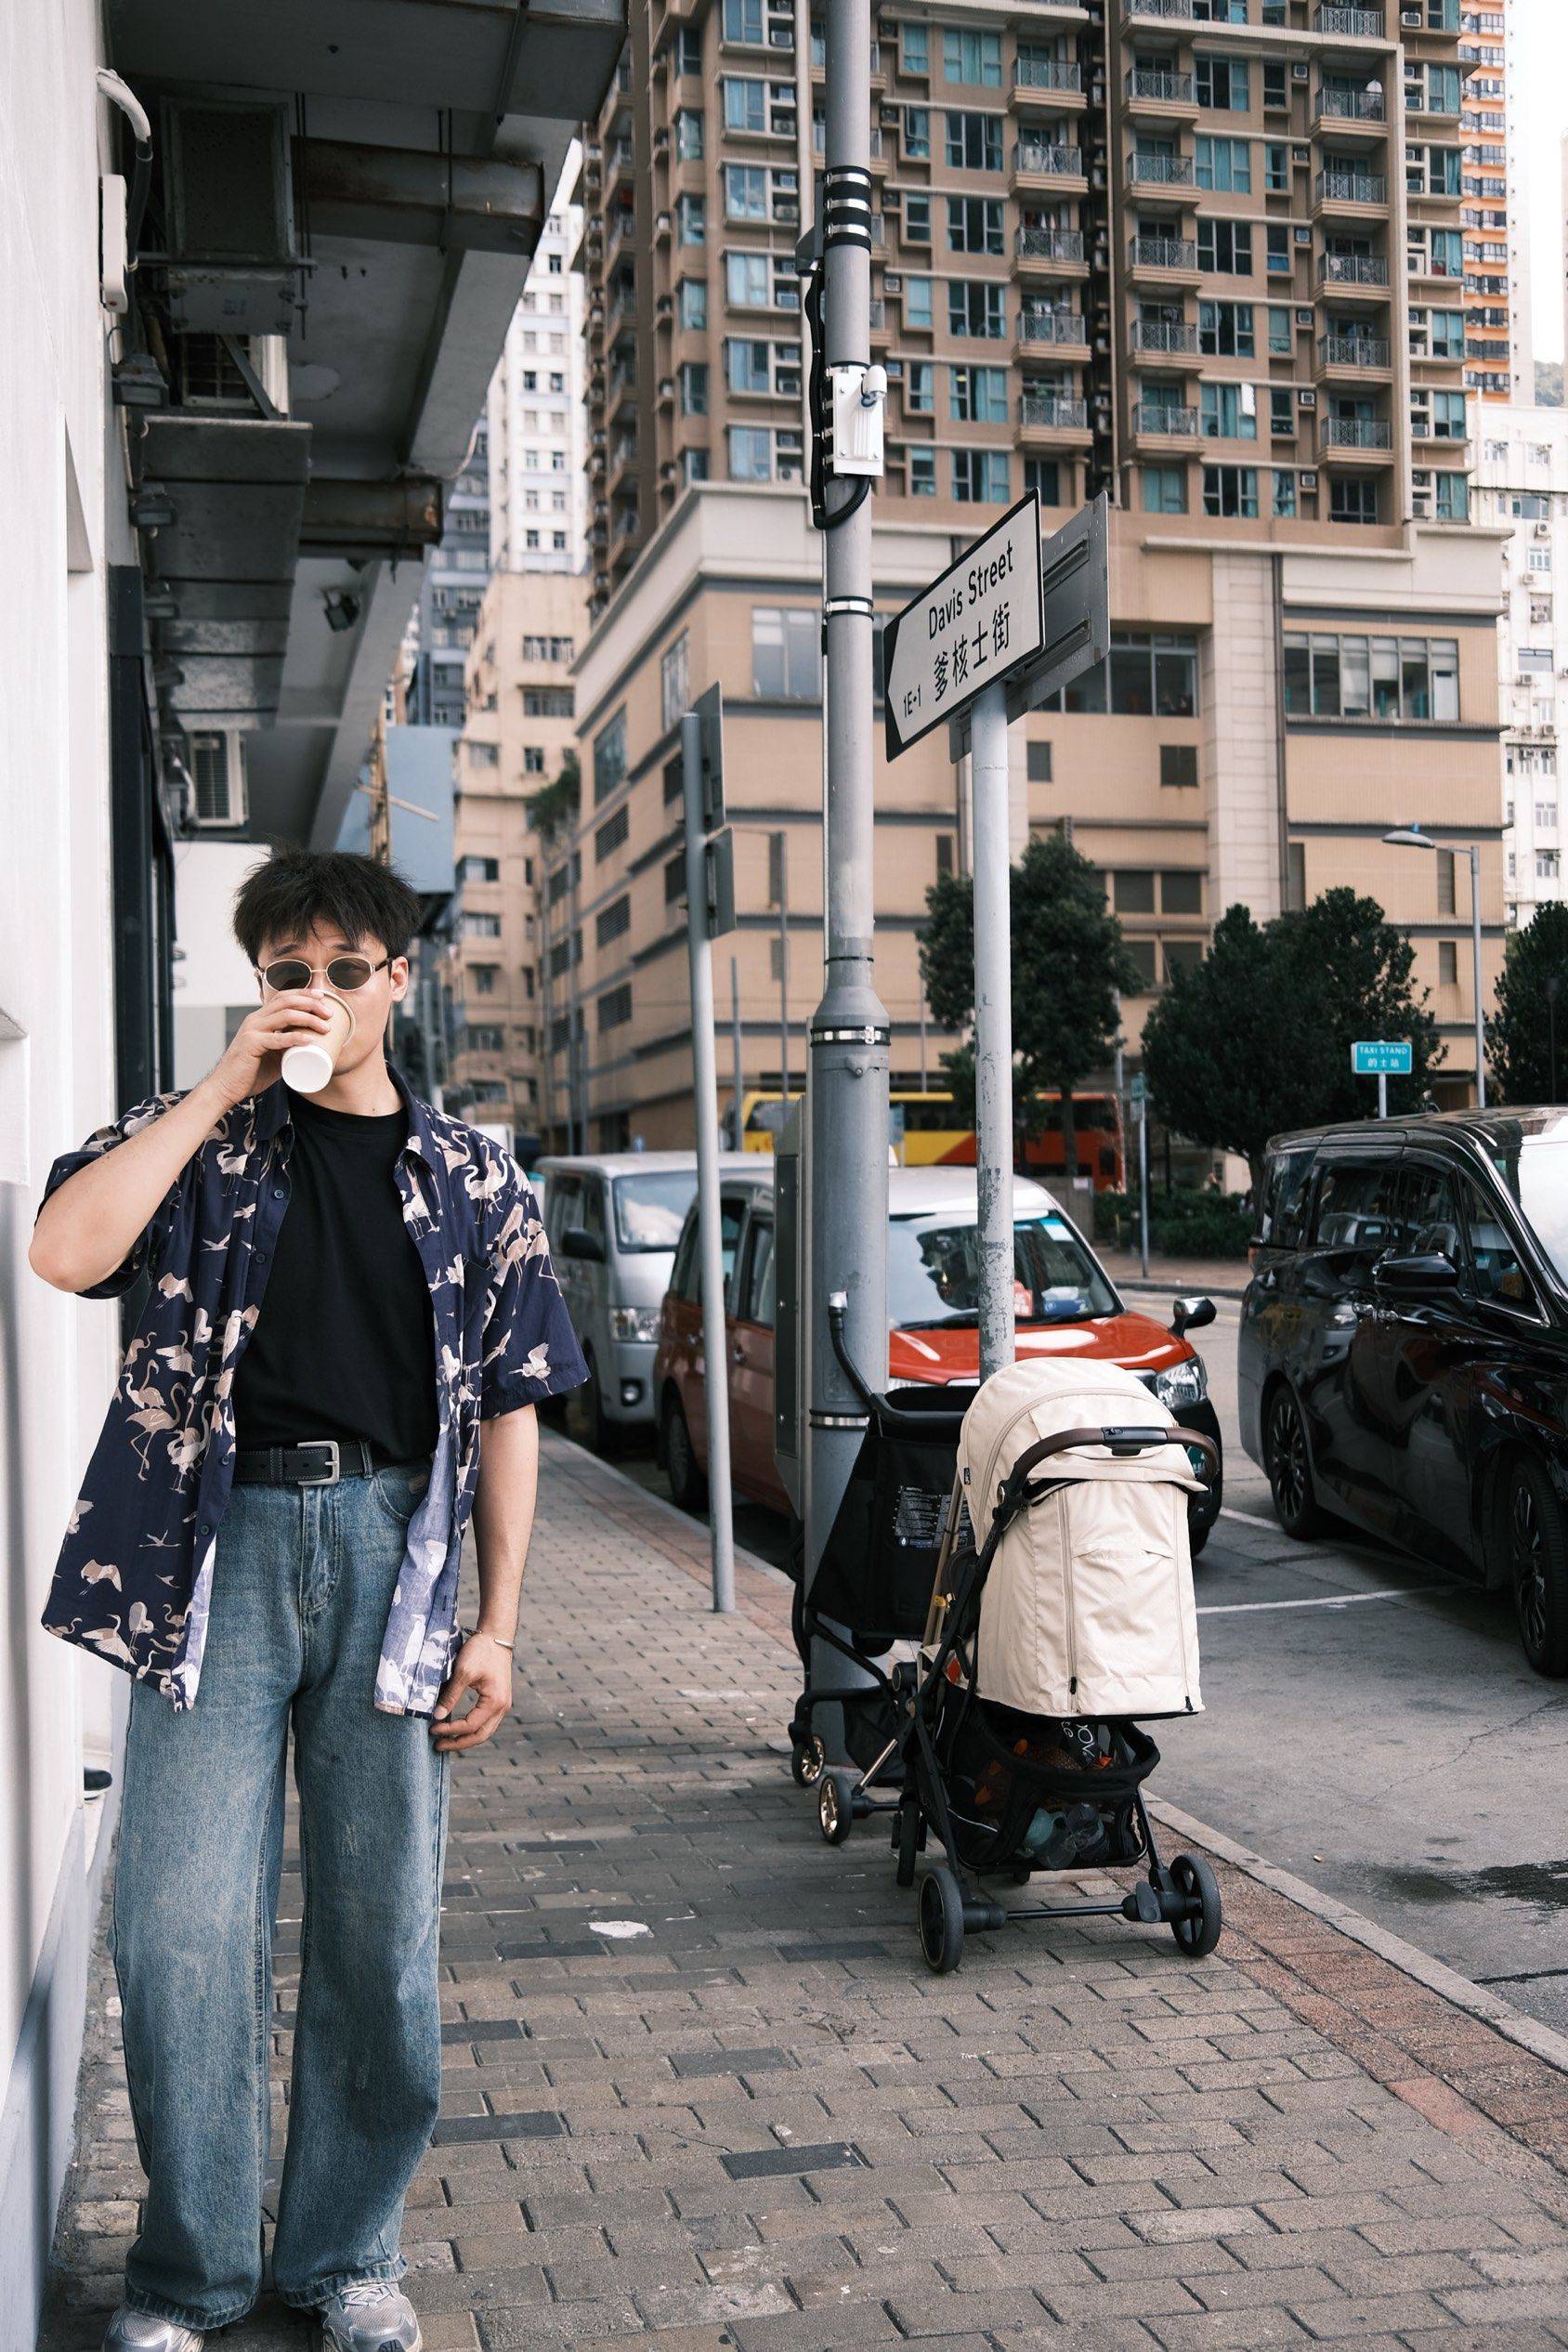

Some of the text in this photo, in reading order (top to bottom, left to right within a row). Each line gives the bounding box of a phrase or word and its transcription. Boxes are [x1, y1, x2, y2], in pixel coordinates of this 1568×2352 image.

[929, 539, 1013, 641] Davis Street
[934, 601, 1011, 702] 爹核士街
[1359, 1046, 1408, 1054] TAXI STAND
